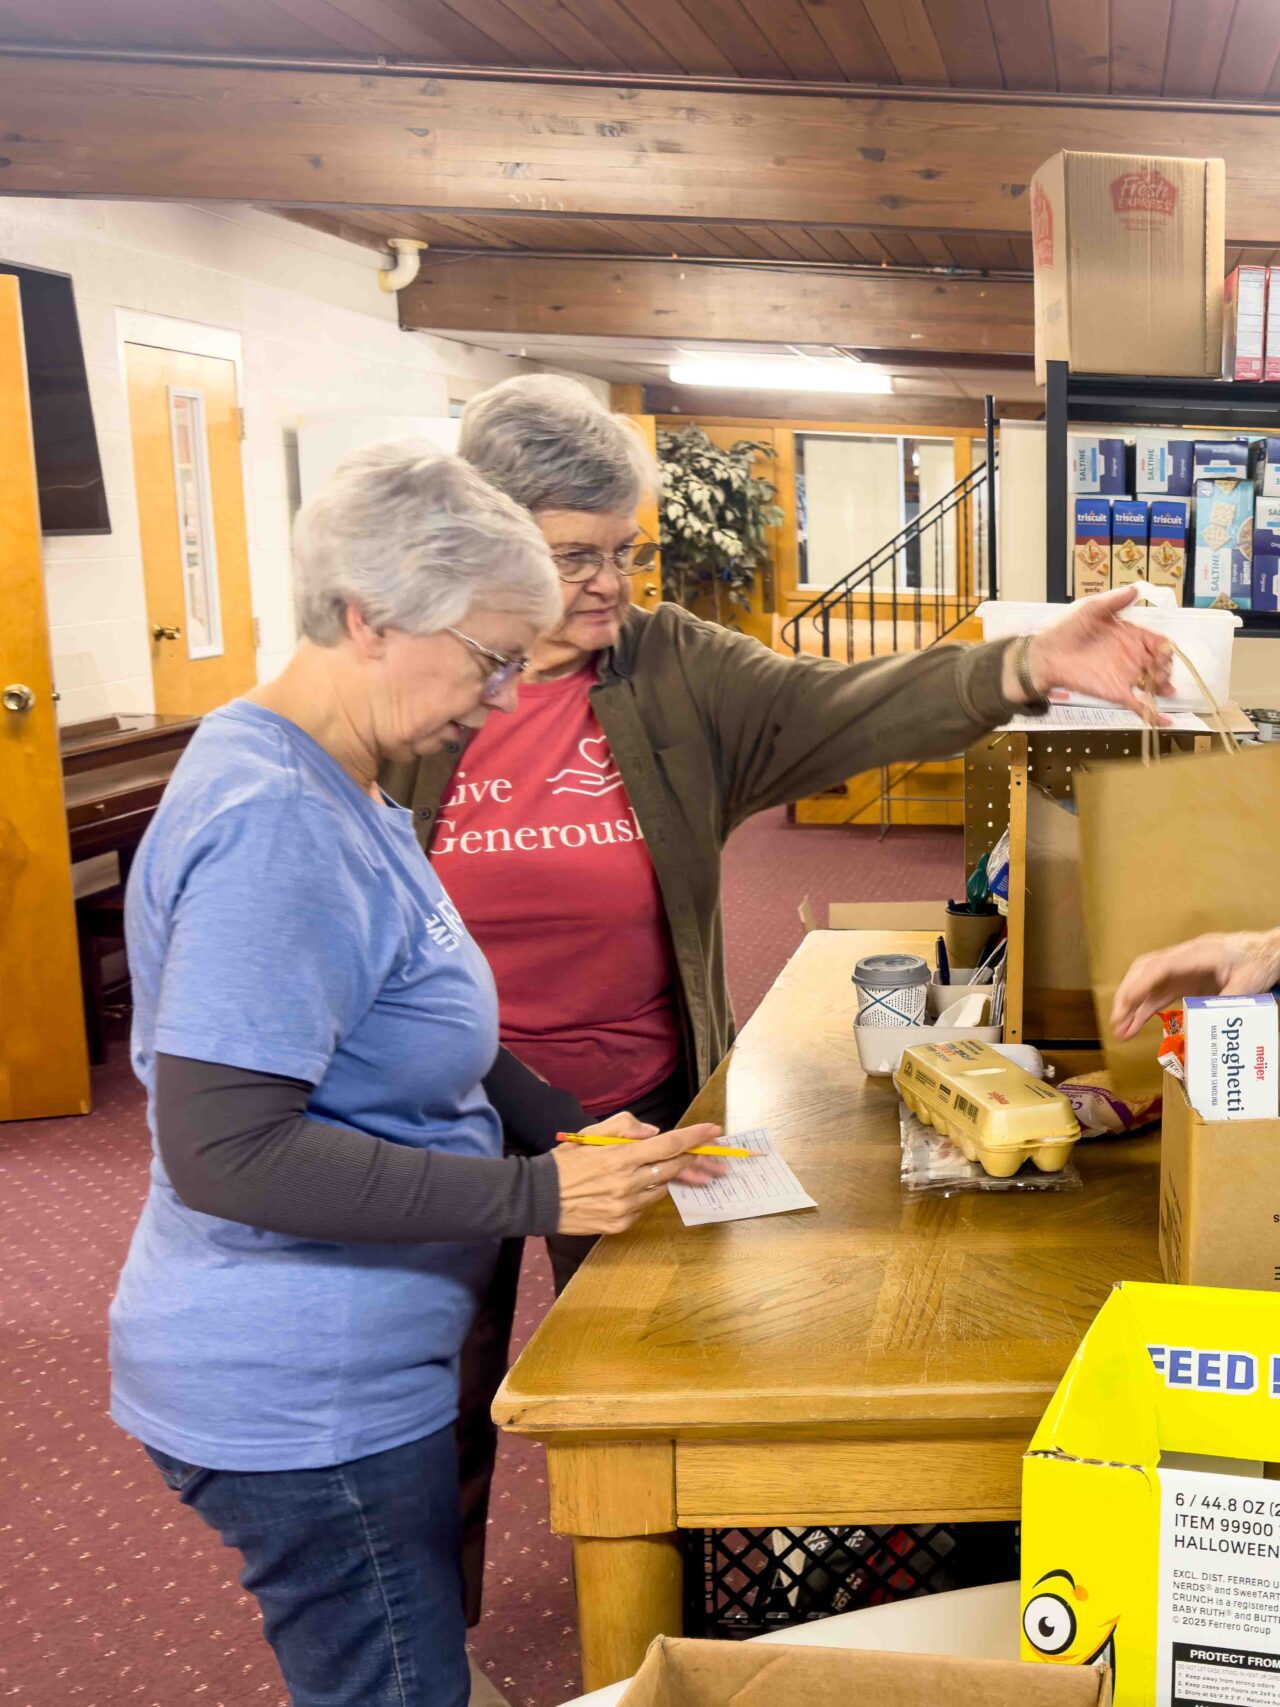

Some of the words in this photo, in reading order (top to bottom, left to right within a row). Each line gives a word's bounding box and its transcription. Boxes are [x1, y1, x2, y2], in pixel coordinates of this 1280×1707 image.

[1077, 513, 1107, 522] triscuit
[1115, 513, 1145, 523] triscuit
[1153, 515, 1182, 525] triscuit
[1211, 553, 1220, 591] SALTINE
[1221, 1017, 1246, 1112] Spaghetti
[1253, 1046, 1268, 1081] meijer
[1175, 1493, 1185, 1507] 6
[1200, 1494, 1238, 1512] 44.8
[1242, 1499, 1265, 1516] OZ
[1174, 1513, 1215, 1531] ITEM
[1220, 1518, 1273, 1537] 99900
[1174, 1534, 1280, 1559] HALLOWEEN
[1172, 1581, 1213, 1592] NERDS®
[1214, 1586, 1231, 1596] and
[1173, 1569, 1199, 1580] EXCL.
[1201, 1572, 1226, 1583] DIST.
[1227, 1575, 1271, 1588] FERRERO
[1172, 1592, 1214, 1604] CRUNCH
[1215, 1597, 1224, 1606] is
[1225, 1599, 1231, 1607] a
[1233, 1600, 1280, 1613] registered
[1172, 1603, 1198, 1614] BABY
[1199, 1607, 1231, 1618] RUTH®
[1234, 1612, 1252, 1621] and
[1182, 1616, 1207, 1627] 2025
[1208, 1619, 1241, 1631] Ferrero
[1243, 1623, 1271, 1636] Group
[1190, 1649, 1246, 1665] PROTECT
